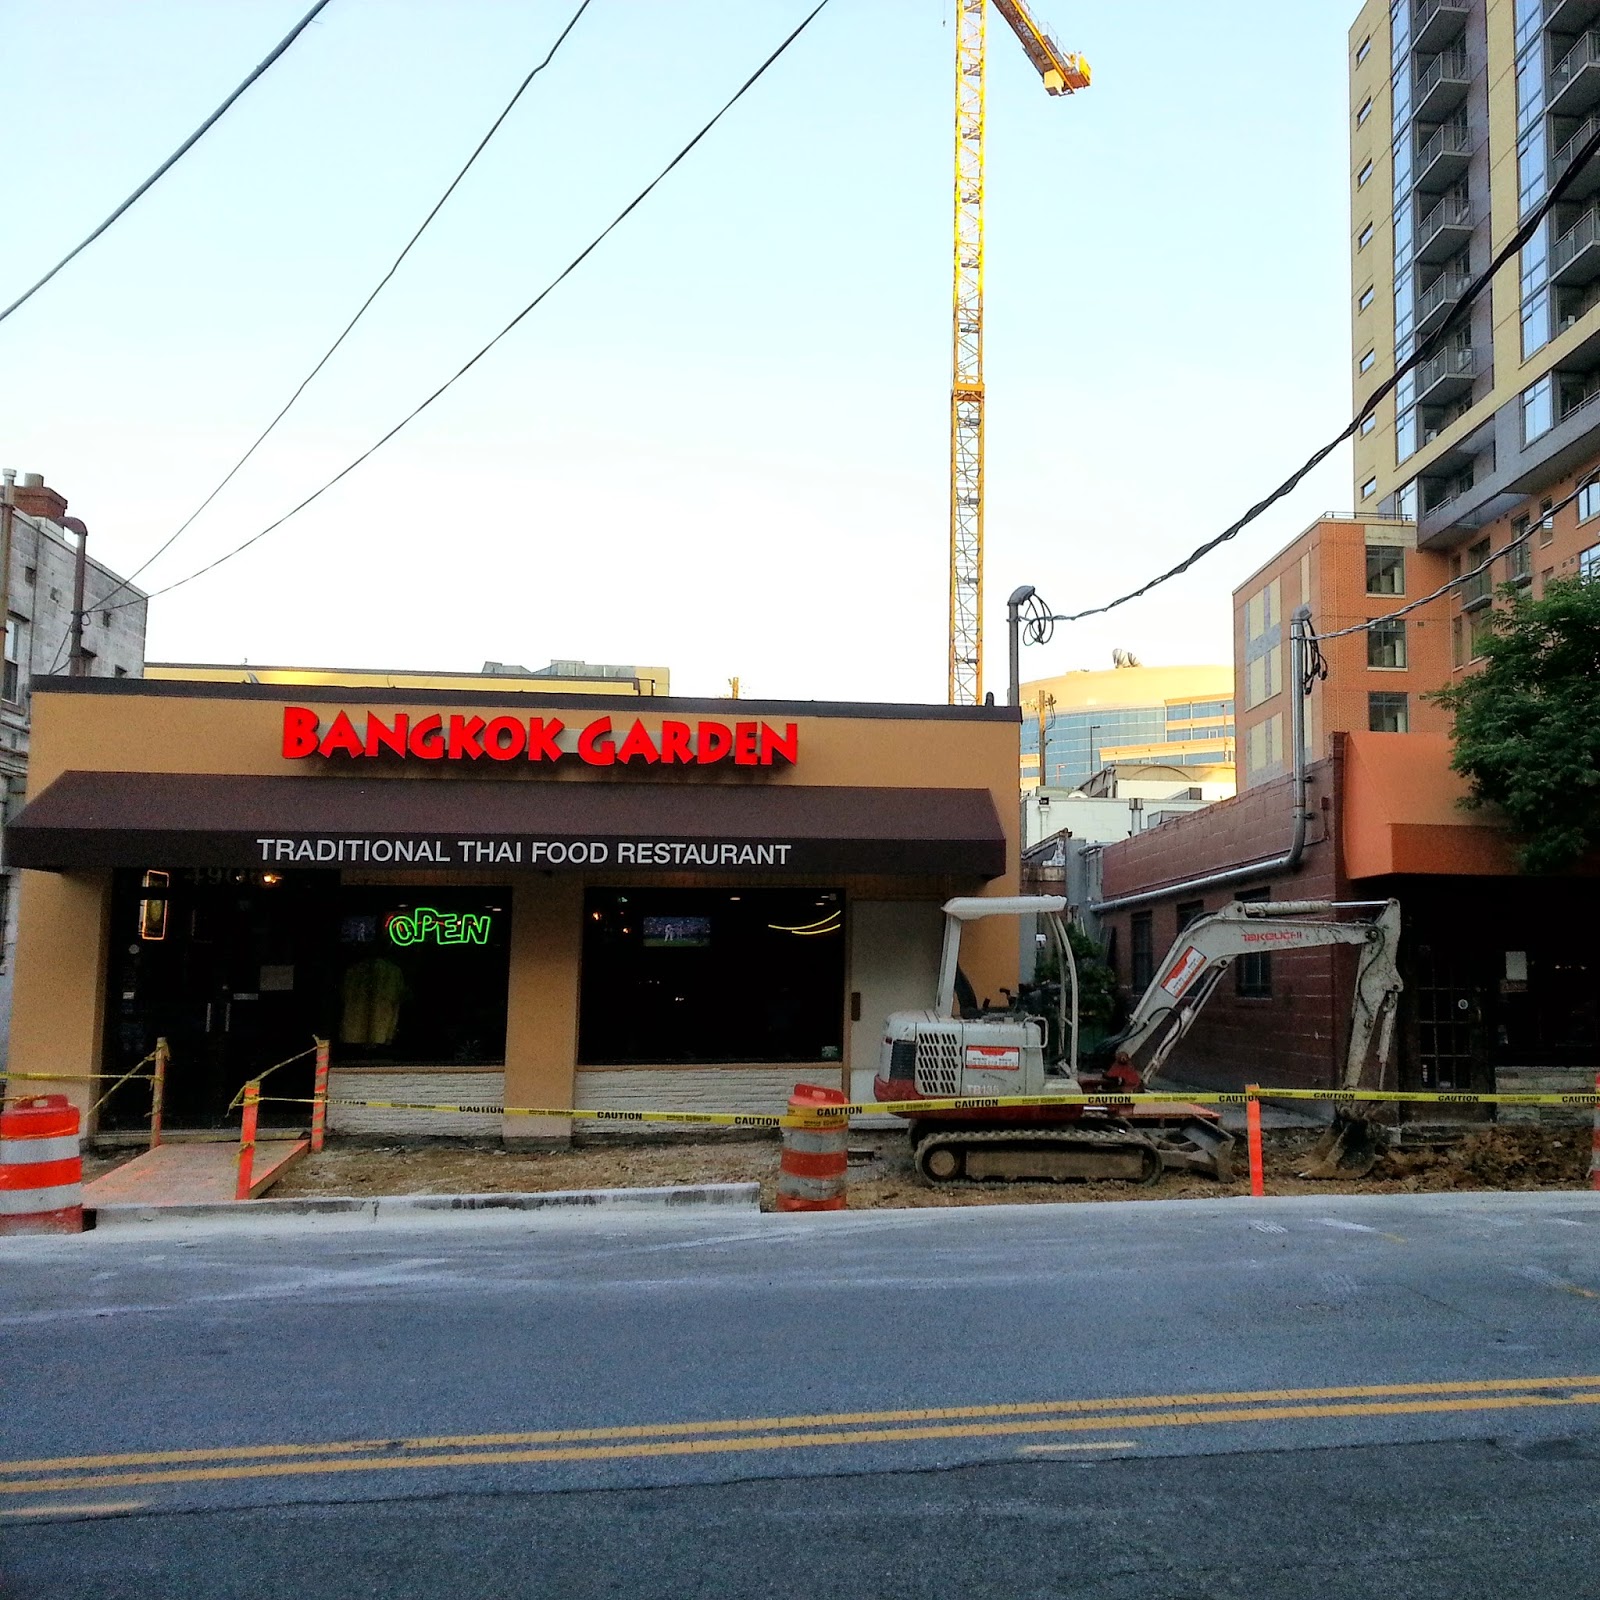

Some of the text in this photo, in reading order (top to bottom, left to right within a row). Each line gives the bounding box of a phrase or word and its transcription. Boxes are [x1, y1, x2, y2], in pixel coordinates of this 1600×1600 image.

[282, 706, 798, 766] BANGKOK GARDEN
[256, 838, 792, 865] TRADITIONAL THAI FOOD RESTAURANT
[389, 908, 491, 946] OPEN
[1088, 1096, 1132, 1104] CAUTION
[1313, 1092, 1355, 1100] CAUTION
[954, 1099, 999, 1109] CAUTION
[597, 1111, 643, 1121] CAUTION
[816, 1106, 863, 1117] CAUTION
[734, 1116, 780, 1127] CAUTION
